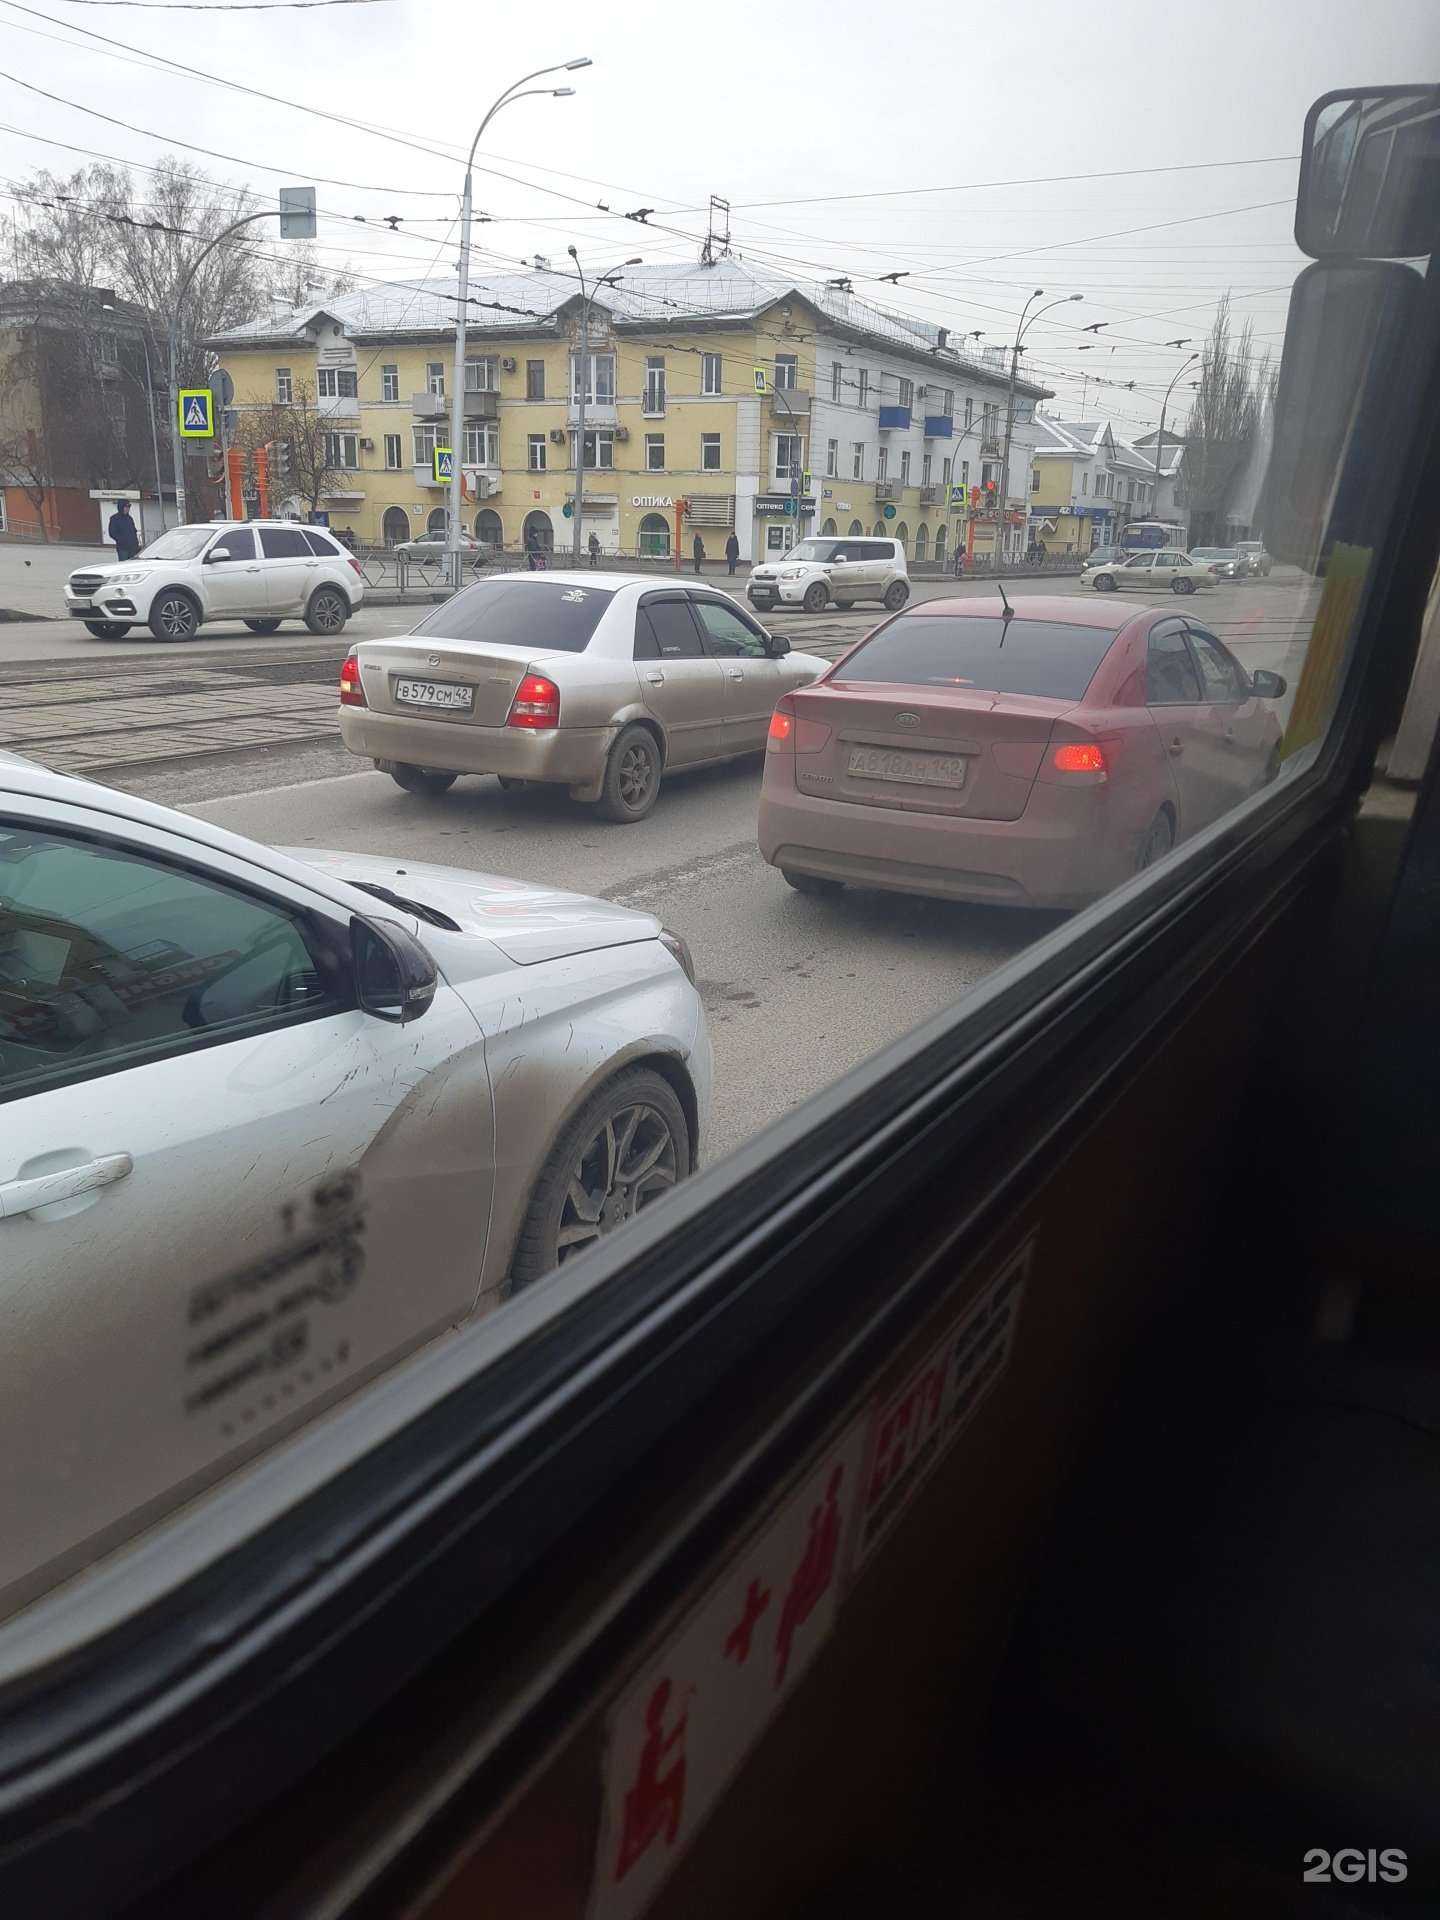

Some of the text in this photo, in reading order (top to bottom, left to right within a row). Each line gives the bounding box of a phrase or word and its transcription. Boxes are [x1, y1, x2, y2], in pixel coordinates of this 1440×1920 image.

[632, 496, 673, 507] ОПТИКА
[756, 502, 784, 511] аптека
[402, 683, 452, 702] В579СМ
